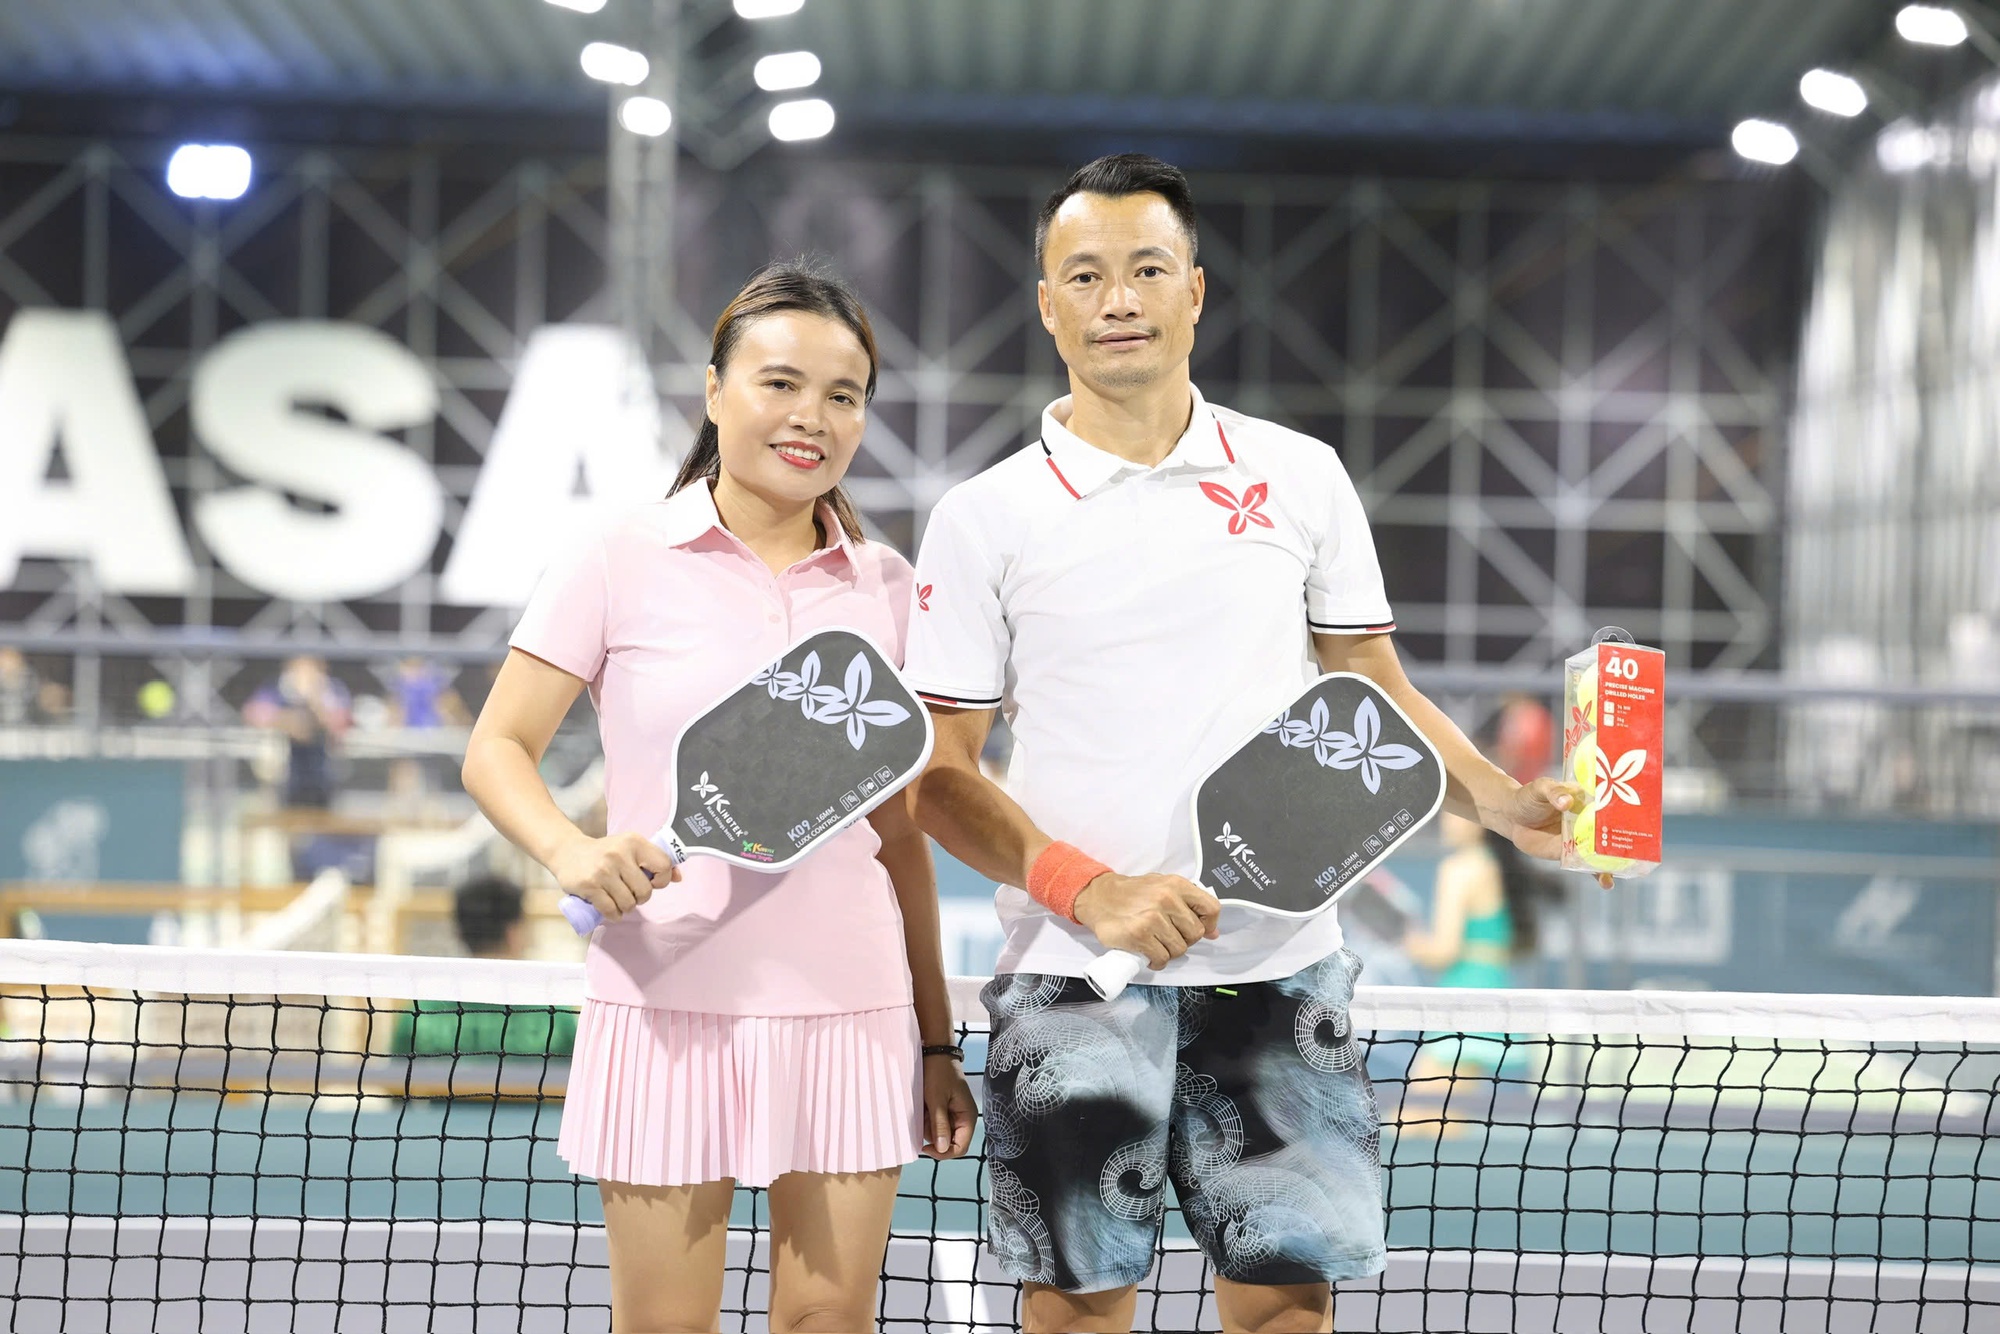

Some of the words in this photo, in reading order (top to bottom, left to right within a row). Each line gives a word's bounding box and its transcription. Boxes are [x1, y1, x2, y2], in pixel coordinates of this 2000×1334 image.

[1605, 656, 1639, 681] 40
[1604, 682, 1628, 691] PRECISE
[1628, 685, 1655, 694] MACHINE
[1604, 690, 1627, 698] DRILLED
[1627, 692, 1646, 700] HOLES
[694, 812, 713, 834] USA
[703, 793, 743, 837] KINGTEK
[706, 806, 716, 817] Make
[714, 816, 726, 830] things
[723, 828, 735, 841] better
[787, 820, 811, 842] K09
[795, 834, 812, 849] LUXX
[811, 814, 841, 837] CONTROL
[1220, 863, 1241, 884] USA
[1229, 843, 1272, 886] KINGTEK
[1232, 857, 1242, 867] Make
[1241, 866, 1253, 880] things
[1251, 878, 1264, 891] better
[1314, 866, 1337, 888] K09
[1323, 880, 1340, 895] LUXX
[1338, 859, 1366, 883] CONTROL
